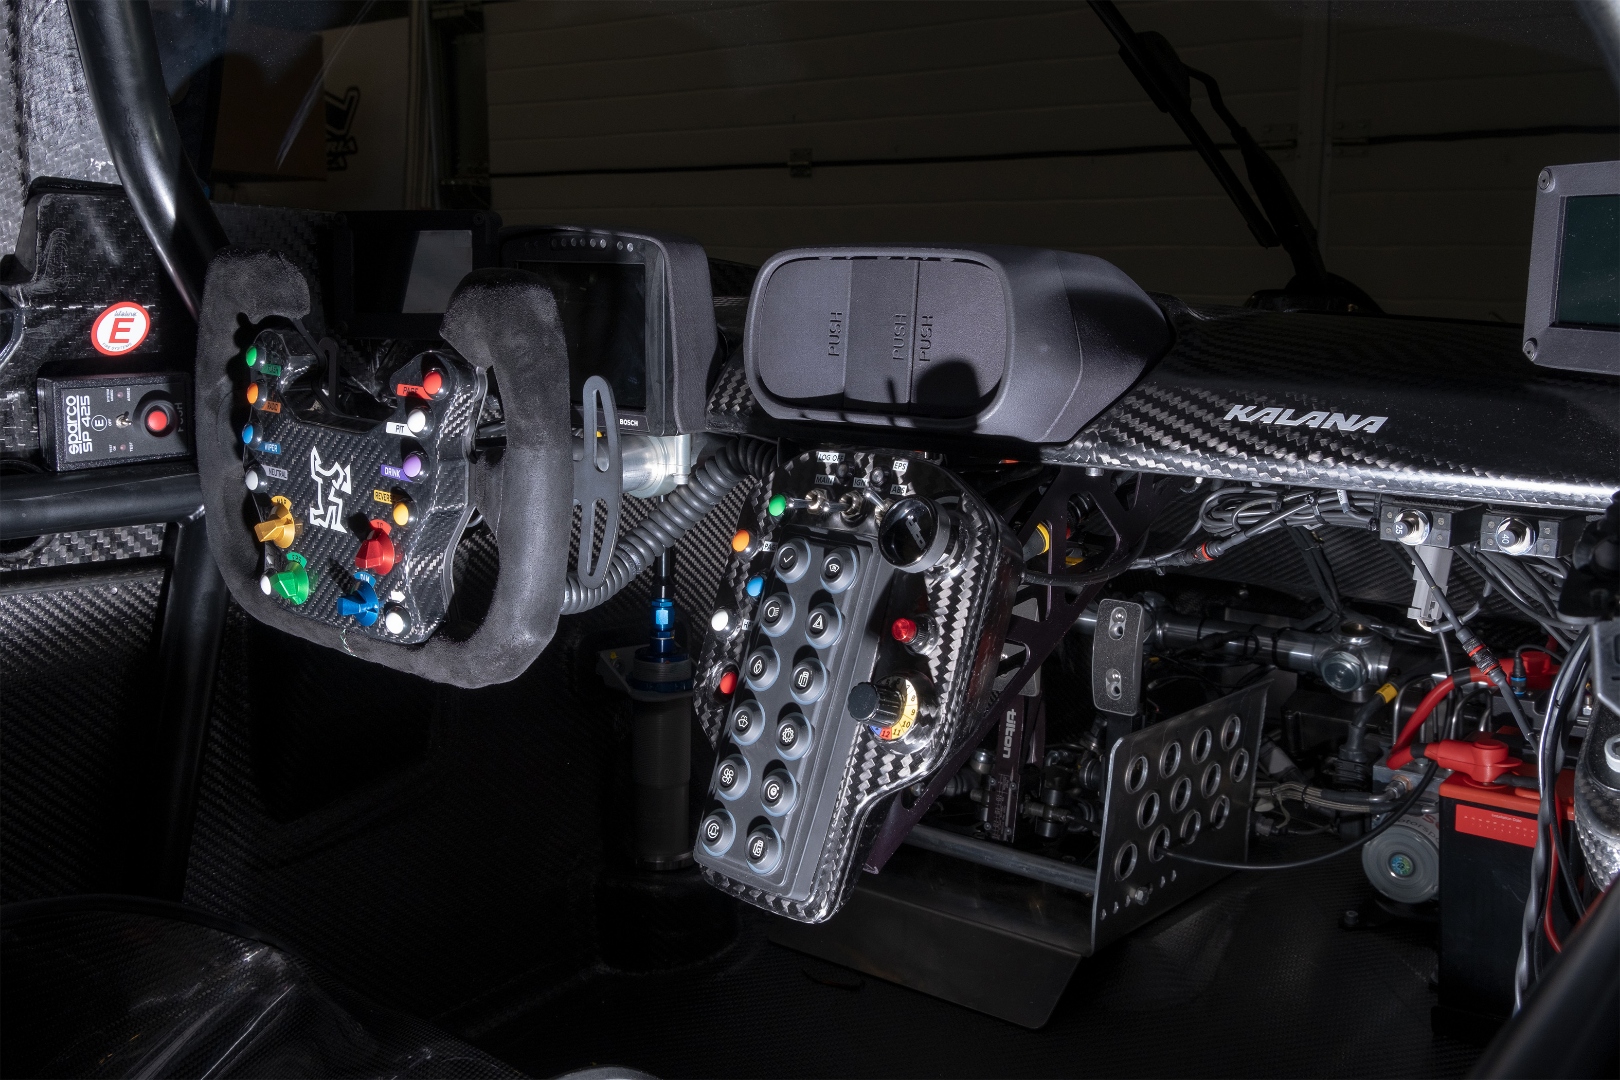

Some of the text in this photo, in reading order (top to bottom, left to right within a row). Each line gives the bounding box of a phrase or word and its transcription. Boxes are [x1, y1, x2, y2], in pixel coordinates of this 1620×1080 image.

[109, 318, 135, 343] E
[828, 312, 842, 356] PUSH
[893, 314, 907, 360] PUSH
[919, 316, 933, 361] PUSH
[267, 402, 278, 411] RADIO
[80, 395, 93, 452] SP 425
[619, 418, 639, 427] BOSCH
[1223, 404, 1388, 434] KALANA
[66, 395, 82, 454] sparco
[396, 424, 405, 434] PIT
[818, 453, 844, 462] LOG OFF
[894, 462, 907, 470] EPS
[268, 468, 287, 479] NEUTRAL
[384, 467, 401, 479] DRINK
[816, 475, 834, 484] MAIN
[891, 486, 905, 494] ABS
[1395, 524, 1403, 535] 25
[1502, 533, 1510, 544] 40
[764, 543, 777, 551] PAG
[911, 694, 916, 702] 8
[911, 708, 916, 716] 9
[902, 720, 911, 728] 10
[881, 730, 891, 738] 12
[893, 728, 901, 736] 11
[1003, 709, 1016, 758] tilton
